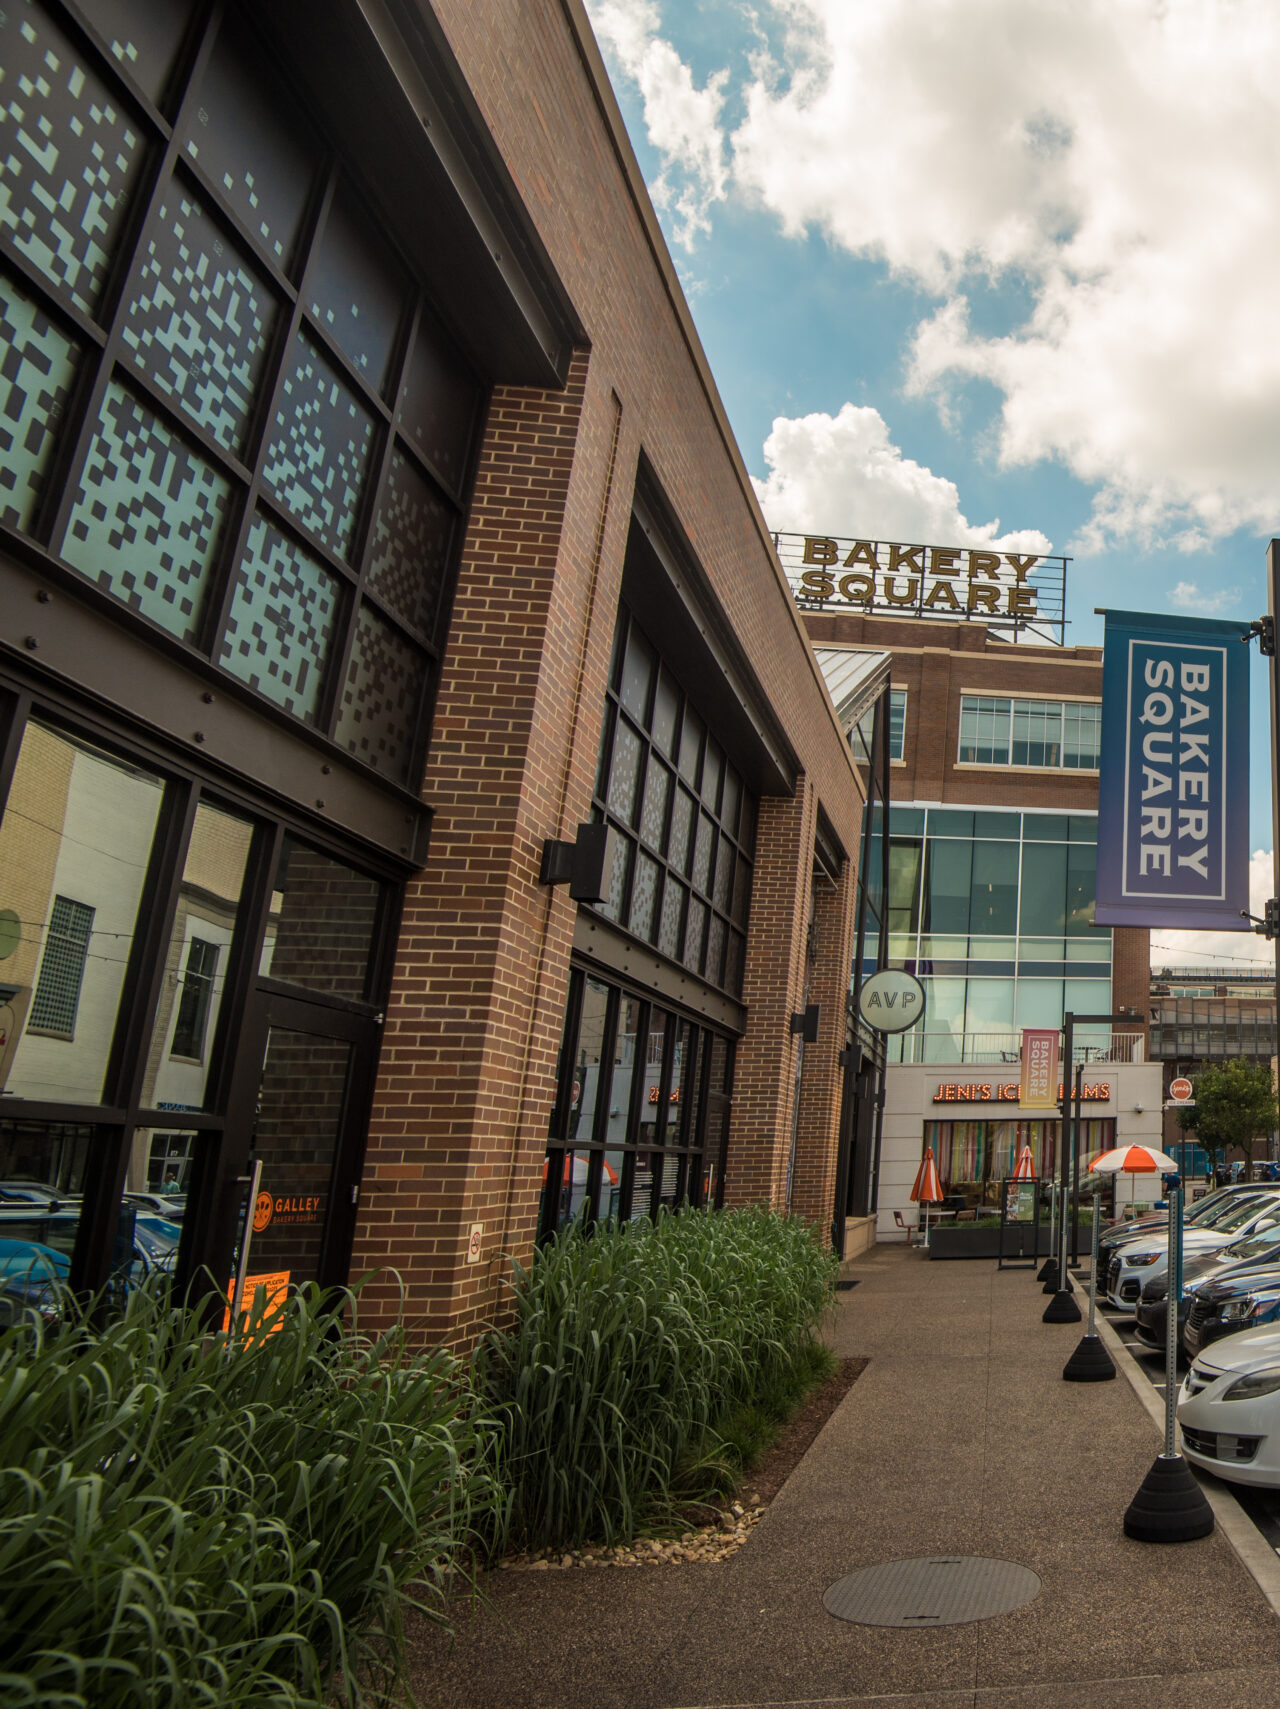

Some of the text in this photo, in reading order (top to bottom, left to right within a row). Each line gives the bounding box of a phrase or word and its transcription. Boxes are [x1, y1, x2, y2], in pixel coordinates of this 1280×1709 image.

[803, 537, 1038, 582] BAKERY
[799, 570, 1038, 615] SQUARE
[1138, 658, 1175, 877] SQUARE
[1178, 661, 1210, 880] BAKERY
[867, 991, 916, 1009] AVP
[1029, 1040, 1041, 1097] SQUARE
[1038, 1040, 1050, 1097] BAKERY
[933, 1083, 992, 1101] JENI'S
[273, 1215, 295, 1225] BAKERY
[275, 1197, 320, 1213] GALLEY
